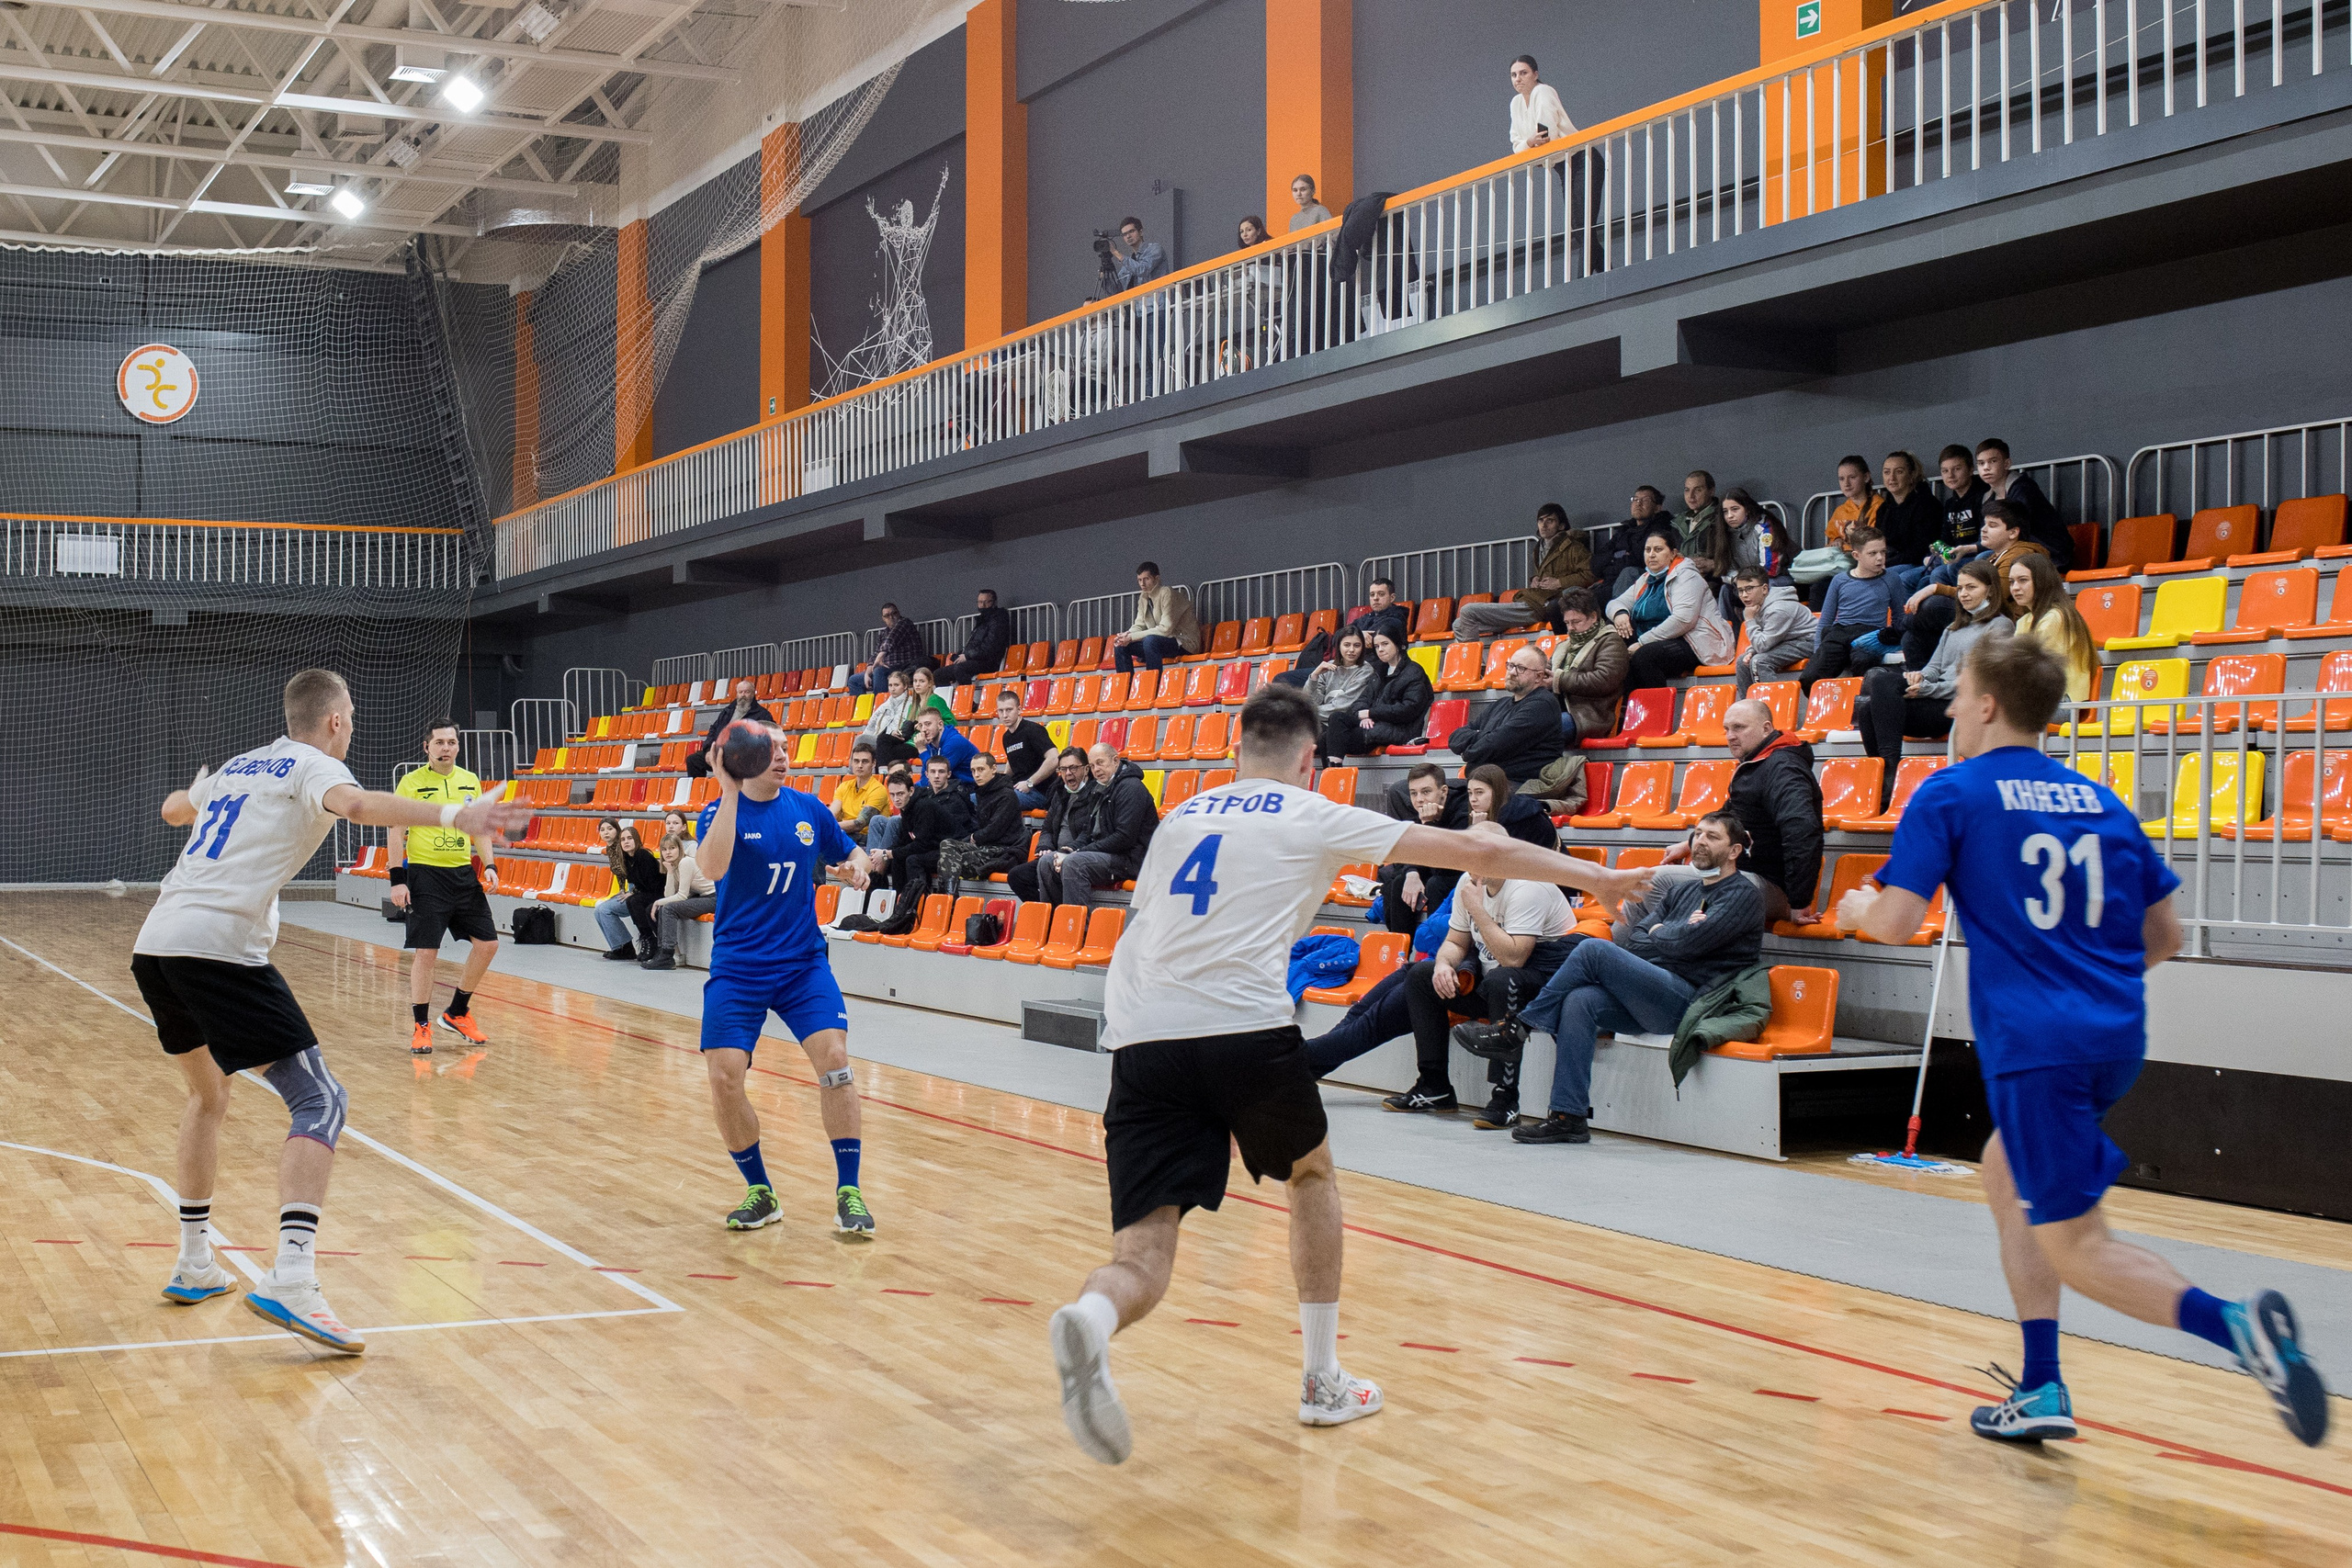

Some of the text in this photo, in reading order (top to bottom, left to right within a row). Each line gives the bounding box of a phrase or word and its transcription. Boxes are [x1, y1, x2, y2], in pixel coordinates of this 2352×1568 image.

[187, 794, 250, 861] 11
[1995, 779, 2104, 814] КНЯЗЕВ
[766, 861, 797, 896] 77
[1170, 833, 1223, 916] 4
[2019, 832, 2105, 931] 31
